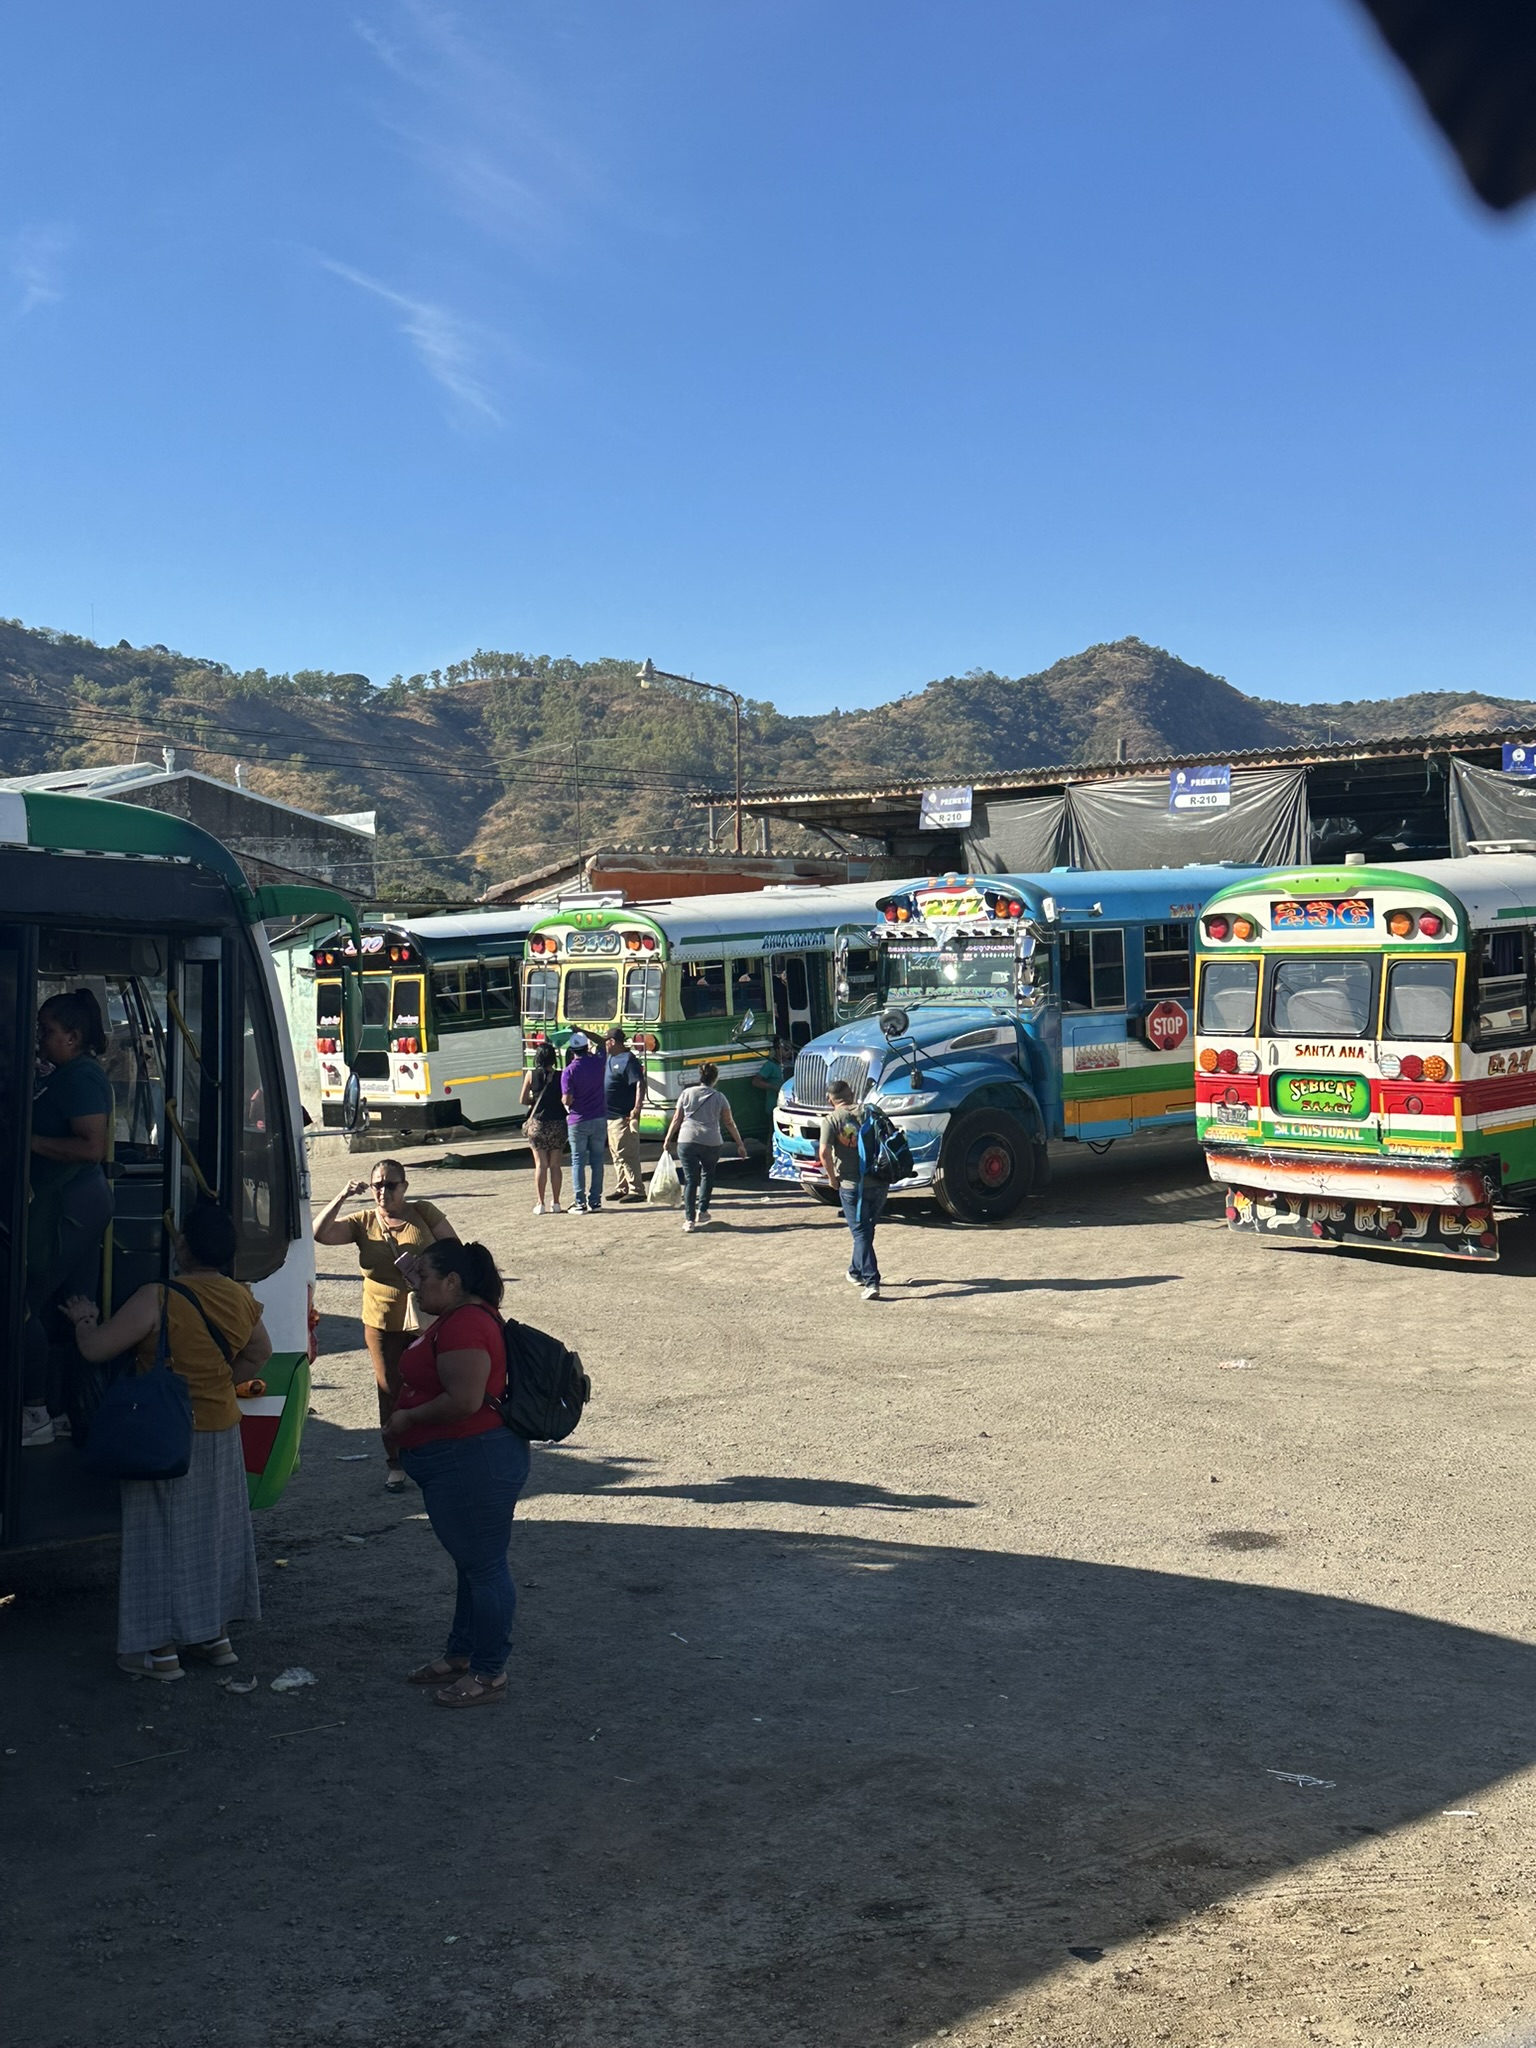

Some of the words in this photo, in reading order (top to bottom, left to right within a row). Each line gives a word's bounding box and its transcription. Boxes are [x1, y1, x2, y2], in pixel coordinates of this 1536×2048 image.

[1190, 796, 1218, 805] R-210
[939, 813, 962, 822] R-210
[926, 898, 982, 916] 277
[762, 932, 826, 950] AHUACHAPAN
[1153, 1016, 1183, 1036] STOP
[1295, 1044, 1335, 1057] SANTA
[1338, 1046, 1365, 1059] ANA
[1507, 1048, 1533, 1074] 24
[1289, 1078, 1356, 1103] SEBICAF
[1306, 1199, 1347, 1222] DE
